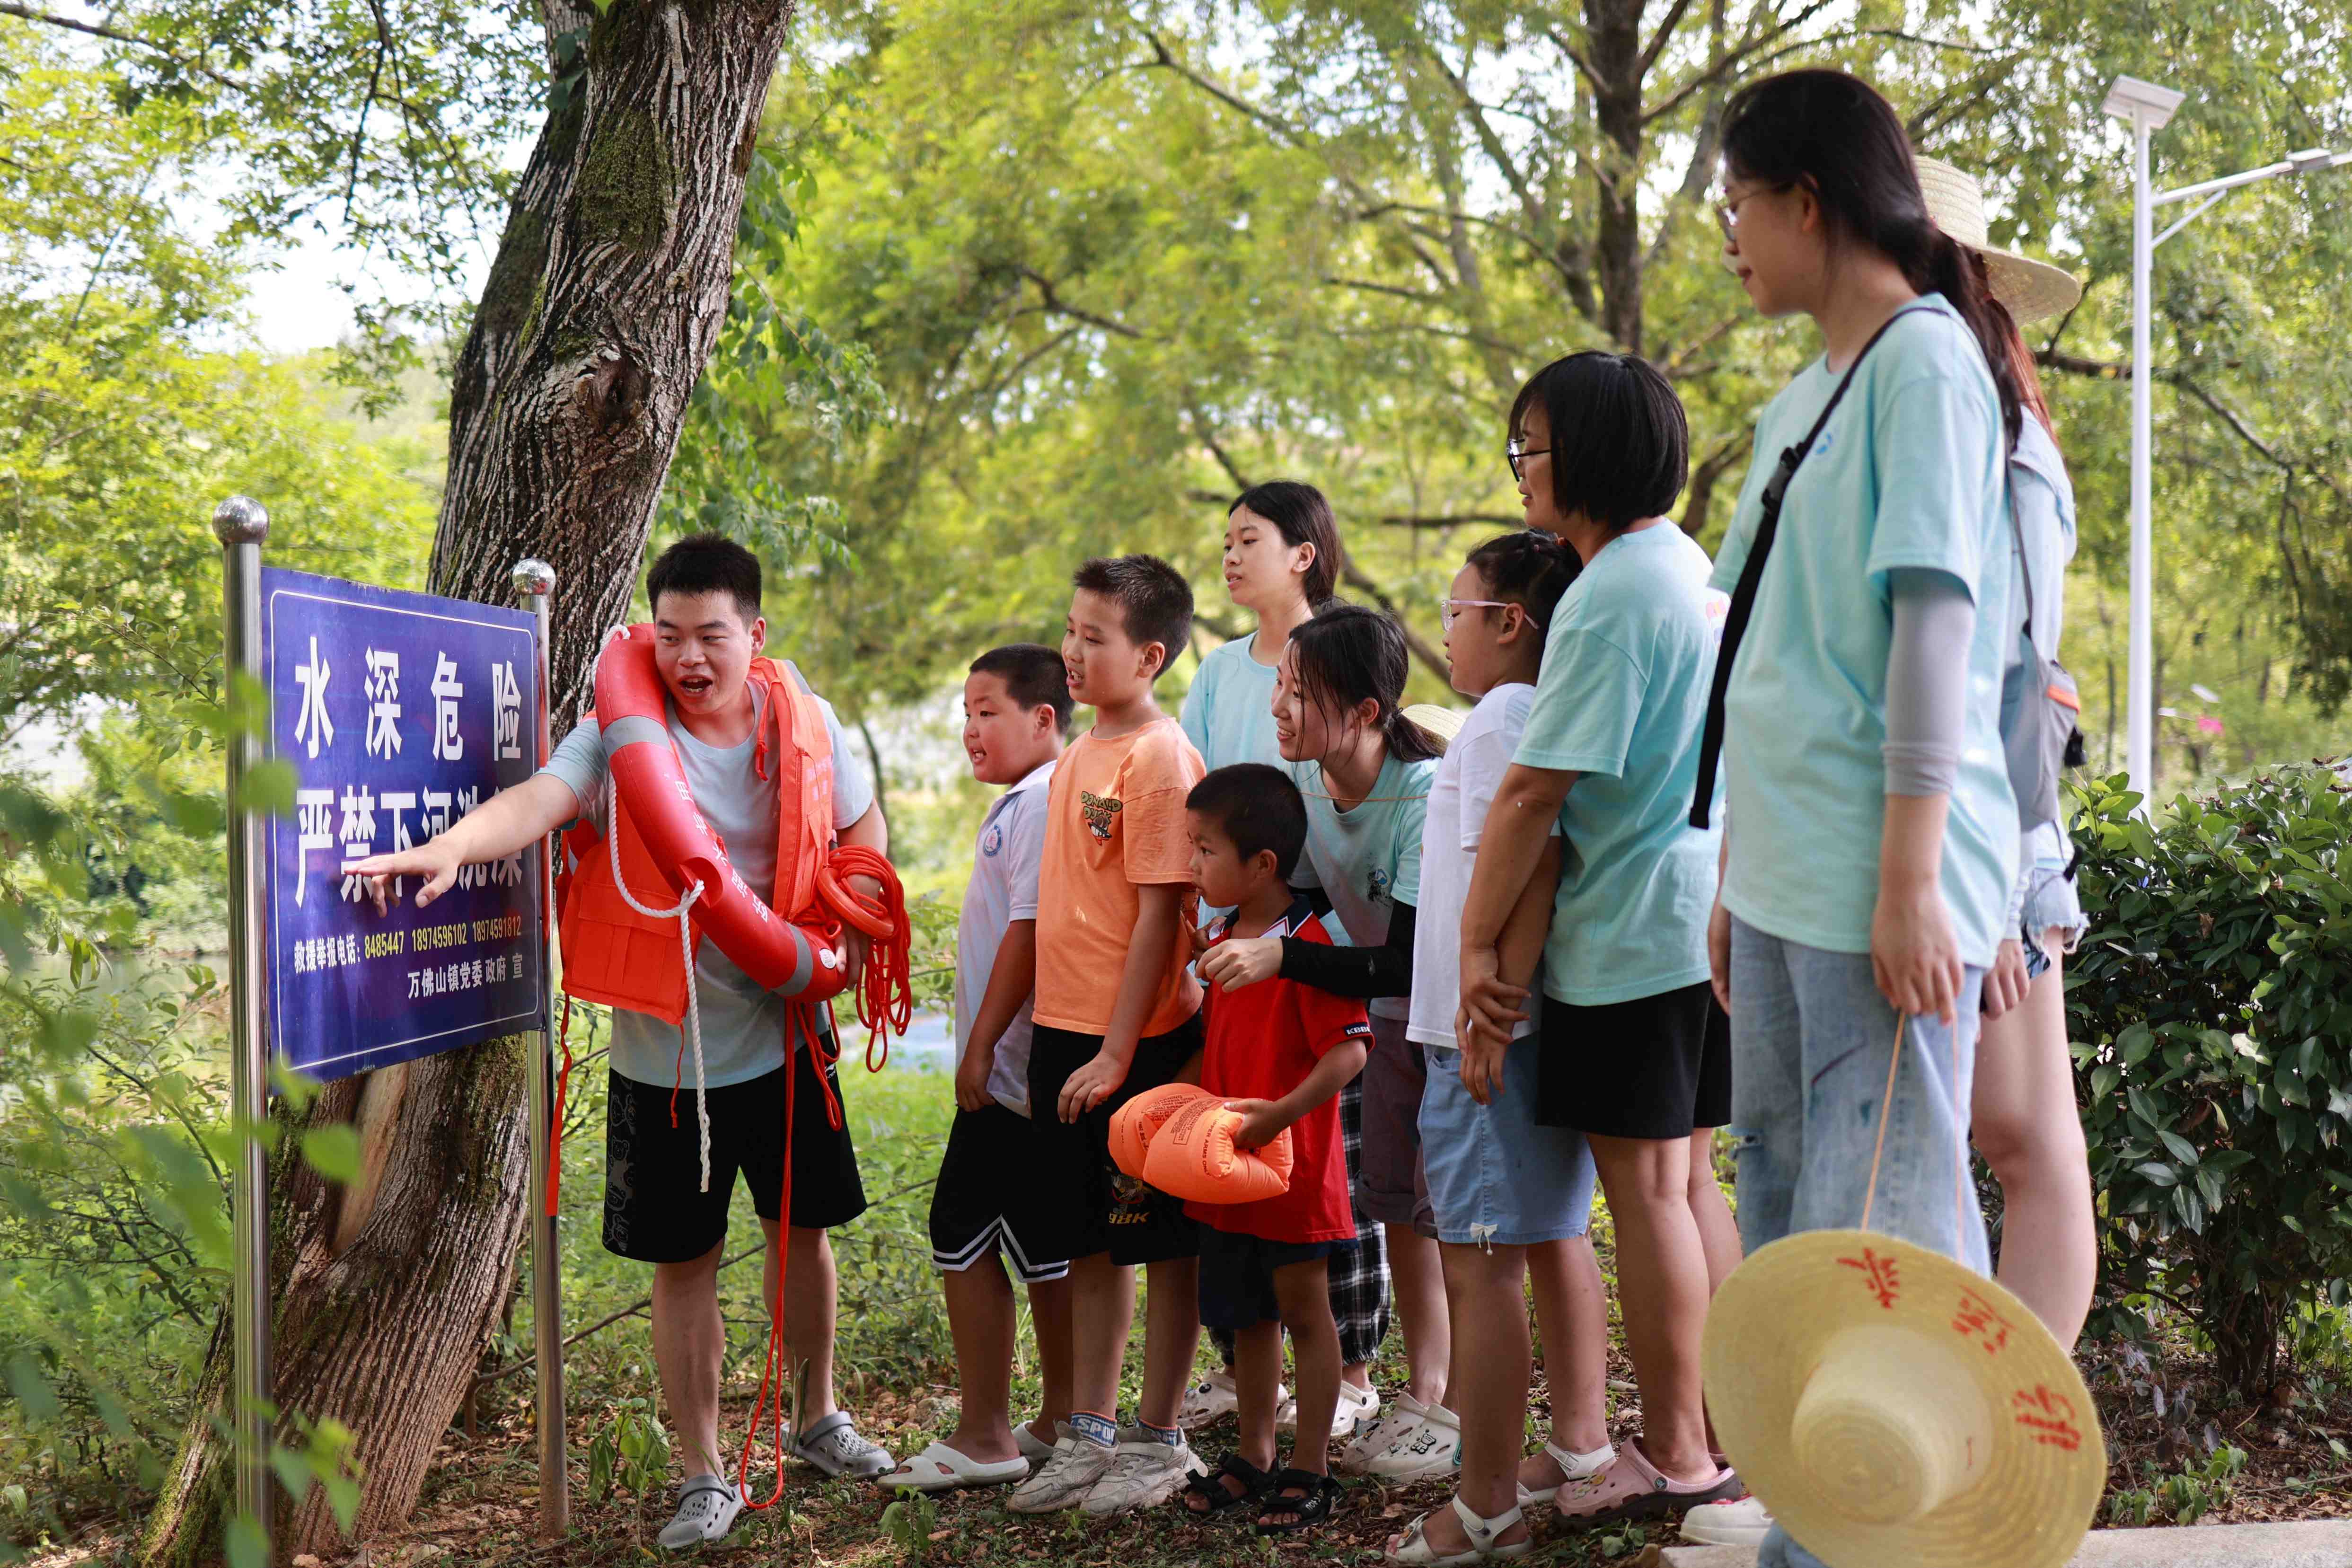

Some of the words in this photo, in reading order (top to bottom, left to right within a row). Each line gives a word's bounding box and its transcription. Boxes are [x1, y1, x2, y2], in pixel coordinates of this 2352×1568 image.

[294, 636, 522, 761] 水深危险
[1081, 791, 1123, 812] DONALD
[674, 781, 768, 923] 防溺水专用
[364, 931, 404, 960] 8485447
[412, 922, 467, 952] 18974596102
[473, 916, 521, 943] 18974591812
[1109, 1212, 1151, 1224] 98K
